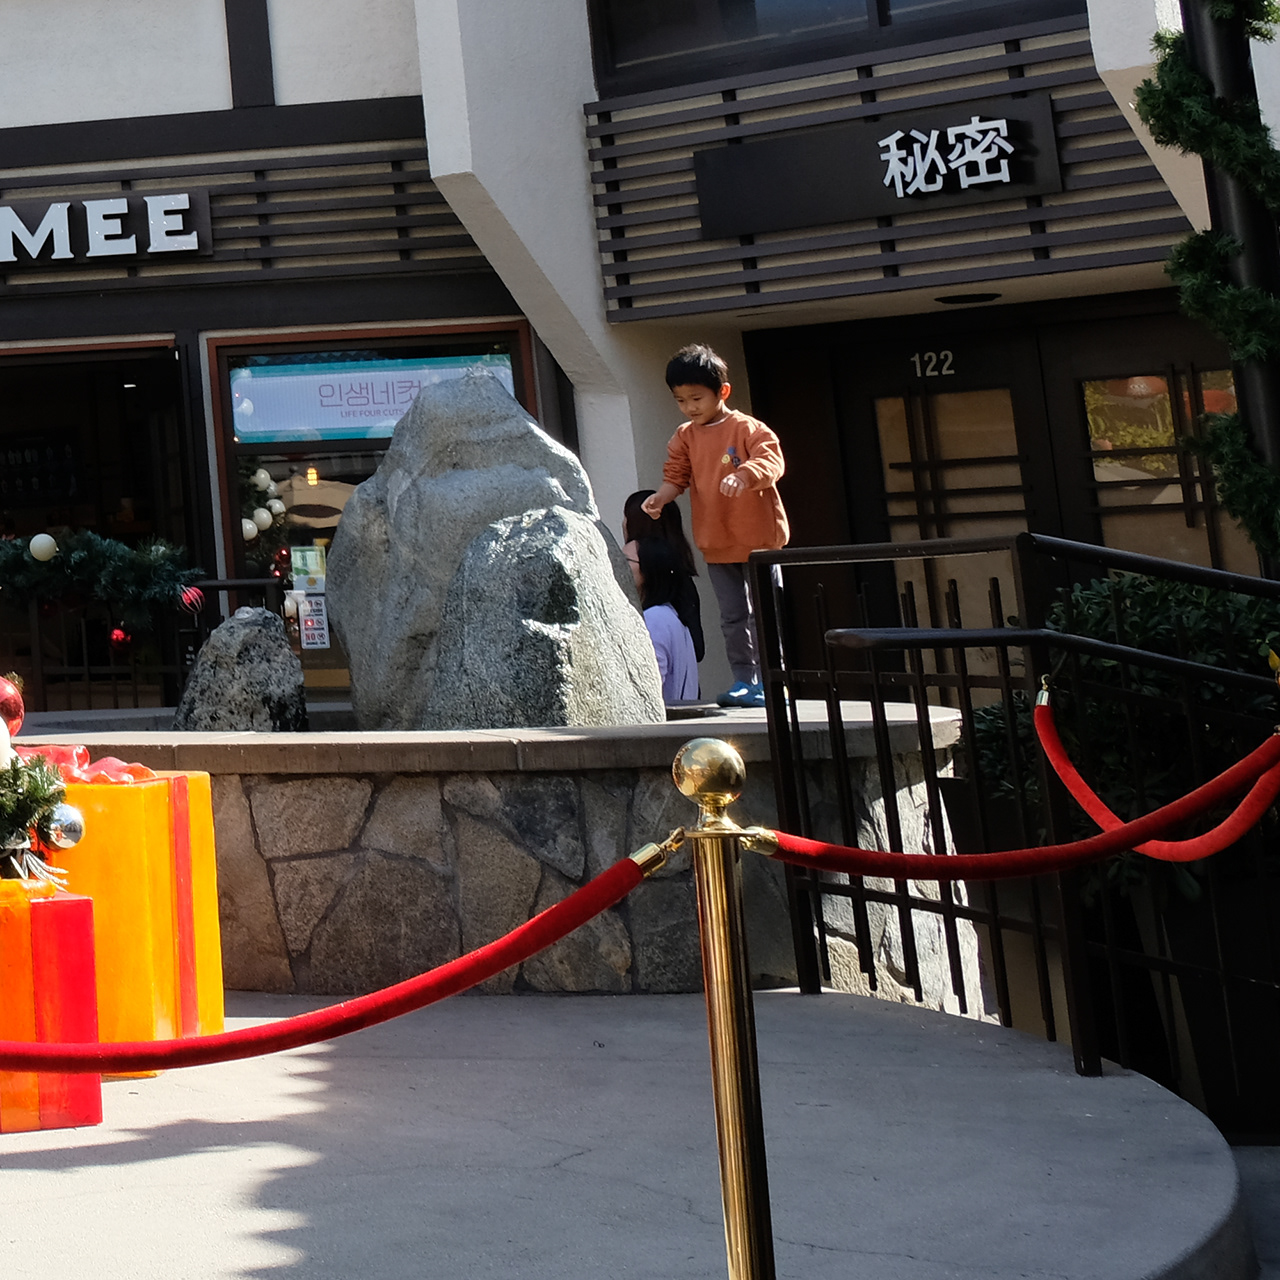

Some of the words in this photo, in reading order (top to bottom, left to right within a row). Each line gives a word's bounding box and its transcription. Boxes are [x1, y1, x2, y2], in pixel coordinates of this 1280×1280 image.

[877, 115, 1015, 199] 秘密
[909, 350, 956, 378] 122
[340, 409, 358, 419] LIFE
[358, 408, 382, 418] FOUR
